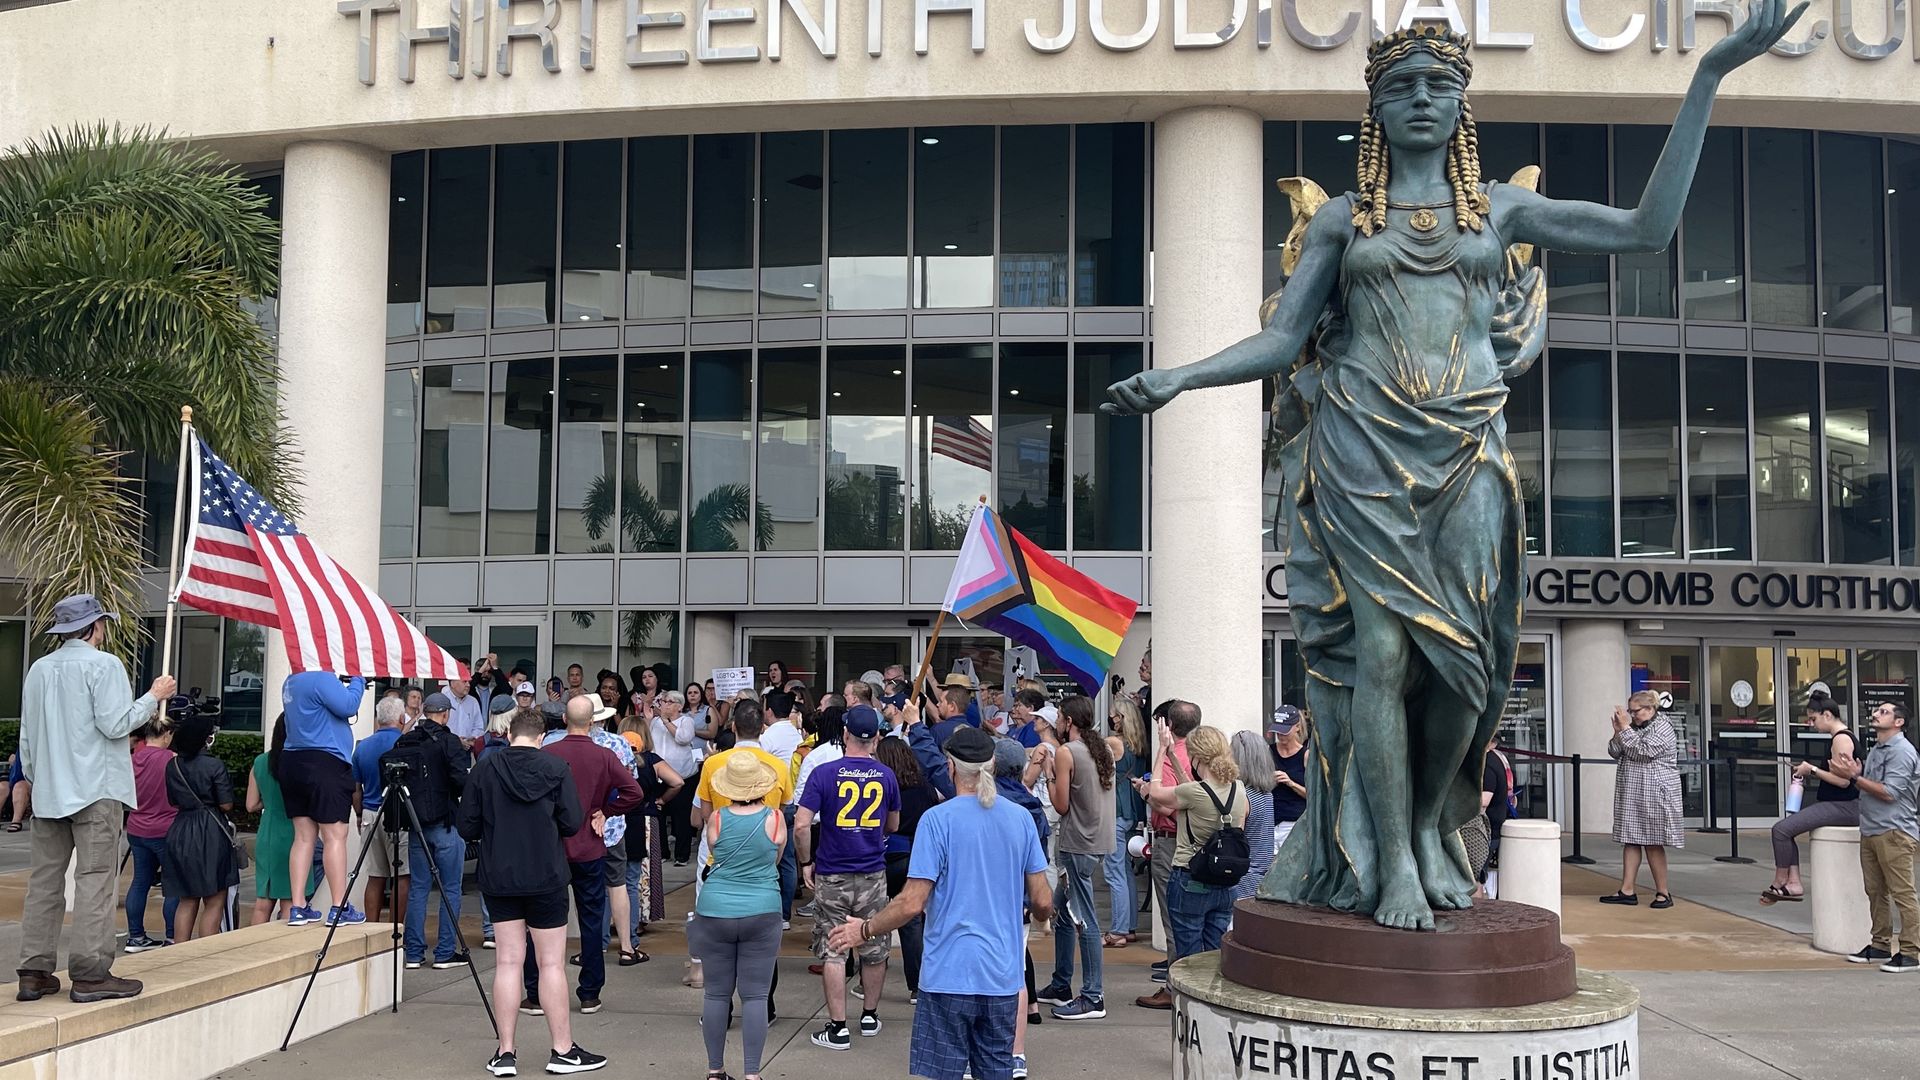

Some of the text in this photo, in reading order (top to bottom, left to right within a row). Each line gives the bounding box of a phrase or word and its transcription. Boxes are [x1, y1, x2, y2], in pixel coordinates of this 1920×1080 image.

[1023, 0, 1535, 54] JUDICIAL
[1526, 567, 1715, 606] GECOMB
[1228, 1031, 1395, 1080] VERITAS
[1500, 1040, 1631, 1080] JUSTITIA
